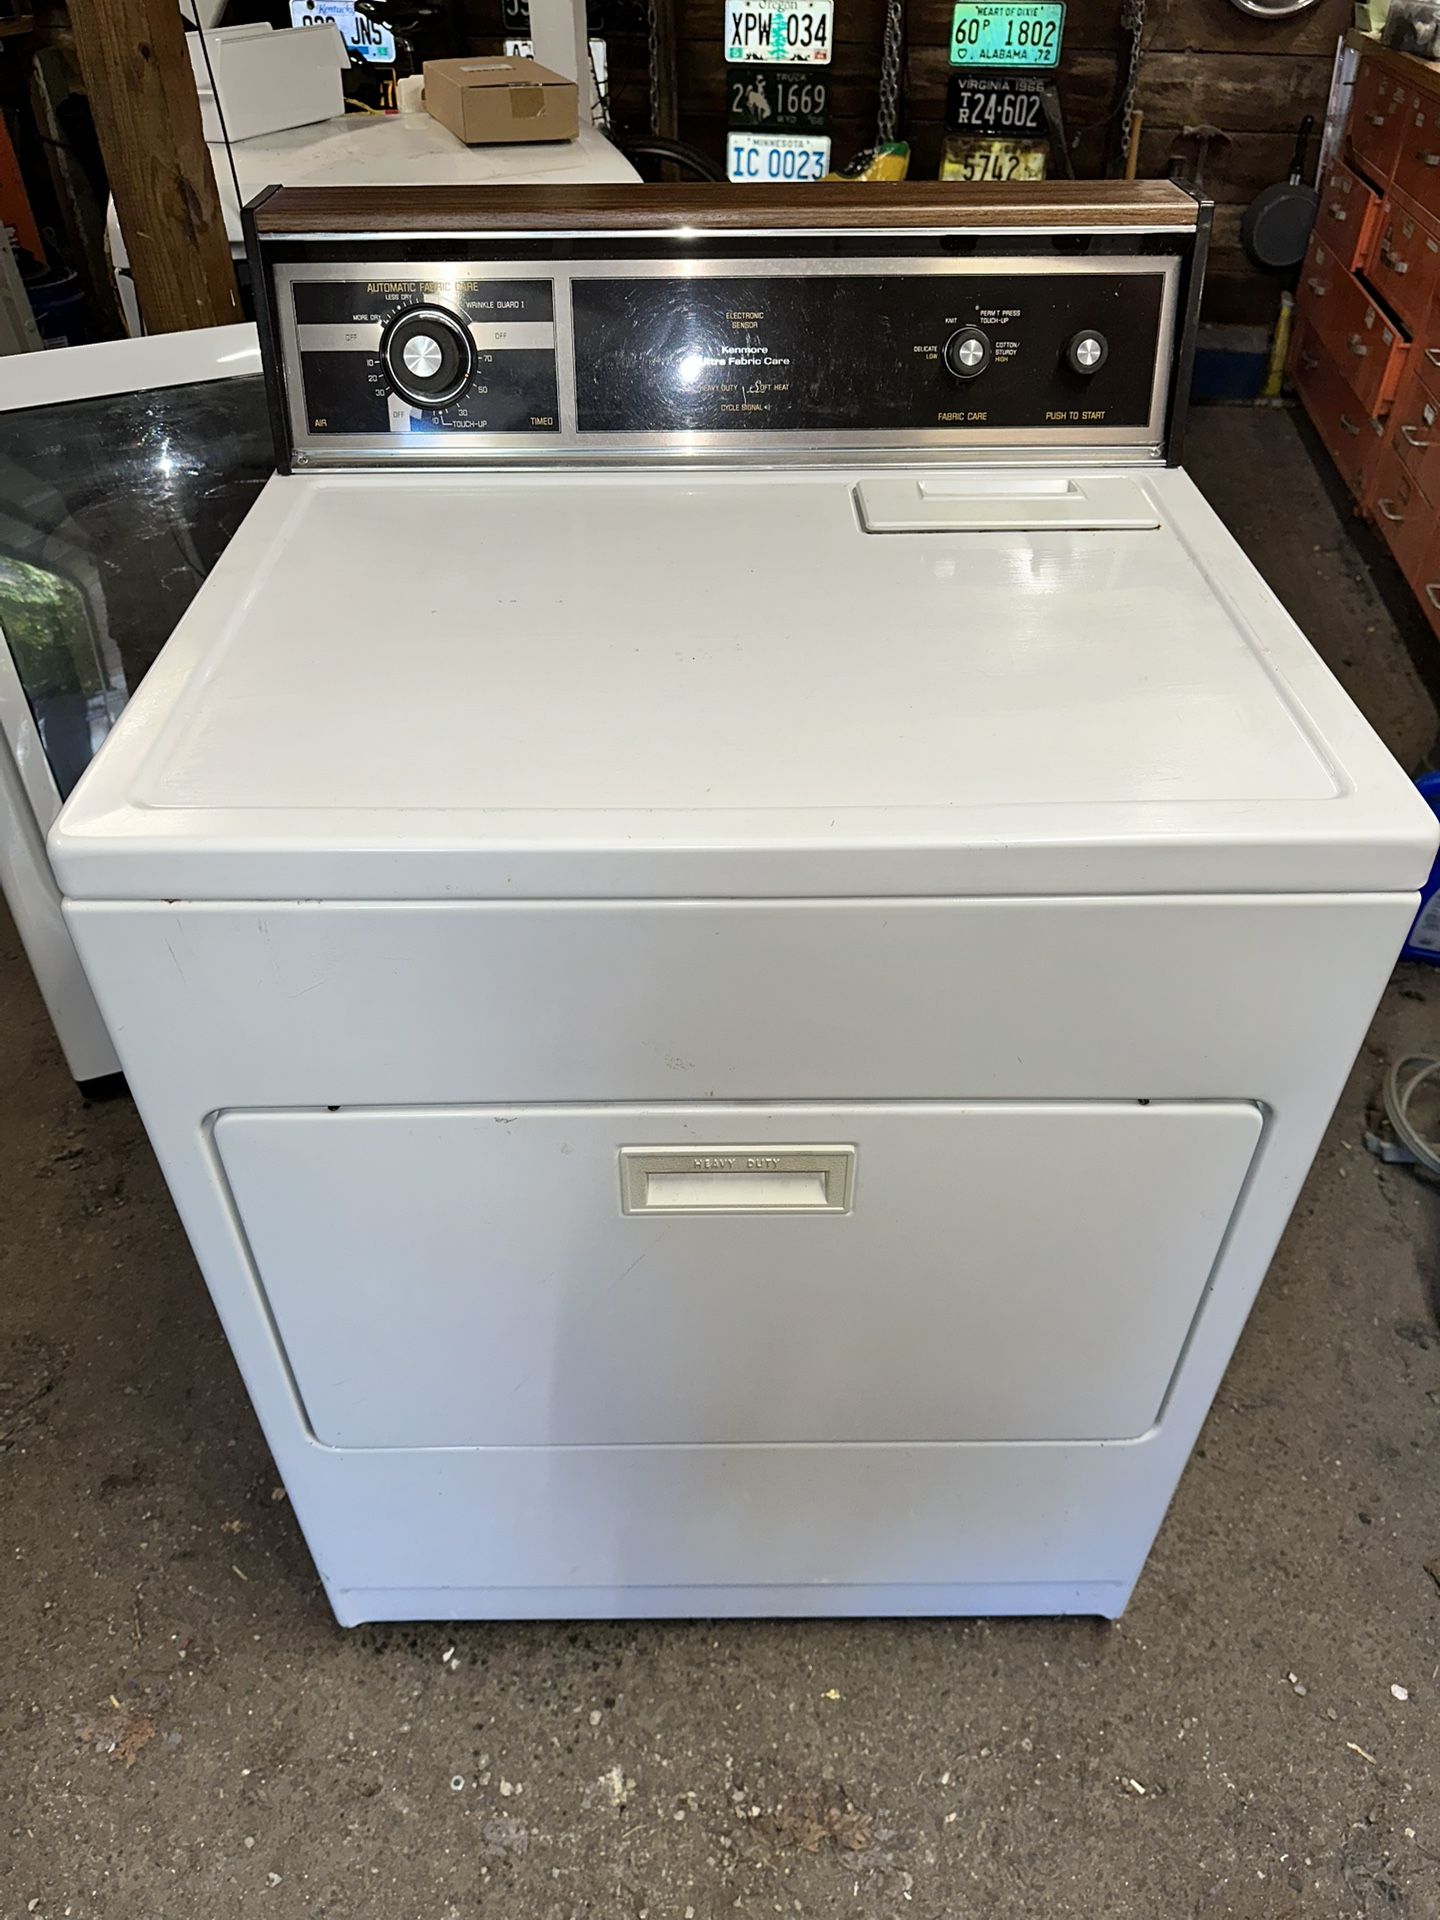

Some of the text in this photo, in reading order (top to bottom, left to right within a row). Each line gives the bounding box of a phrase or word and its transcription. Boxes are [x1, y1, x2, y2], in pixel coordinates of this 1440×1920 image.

[1005, 8, 1015, 16] OF
[732, 13, 827, 47] XPW 034
[1005, 20, 1056, 47] 1802
[980, 49, 1027, 59] ALABAMA
[958, 80, 1010, 90] VIRGINIA
[777, 84, 825, 114] 1669
[768, 148, 824, 180] 0023
[367, 282, 416, 293] AUTOMATIC
[465, 300, 495, 309] WRINKLE
[497, 300, 519, 309] GUARD
[726, 311, 764, 320] ELECTRONIC
[1002, 309, 1021, 317] PRESS
[732, 321, 758, 329] SENSOR
[345, 333, 358, 342] OFF
[494, 332, 508, 341] OFF
[721, 345, 769, 354] Kenmore
[995, 348, 1017, 356] STURDY
[483, 354, 493, 362] 70
[925, 352, 938, 360] LOW
[366, 359, 374, 367] 10
[728, 356, 762, 366] Fabric
[763, 356, 791, 366] Care
[367, 374, 378, 383] 20
[375, 388, 386, 397] 30
[720, 403, 763, 412] CYCLE SIGNAL
[392, 410, 404, 418] OFF
[458, 408, 468, 417] 30
[937, 411, 987, 421] FABRIC CARE
[1046, 410, 1105, 421] PUSH TO START
[314, 418, 328, 427] AIR
[452, 420, 487, 428] TOUCH-UP
[530, 416, 553, 426] TIMED
[694, 1157, 781, 1169] HEAVY DUTY
